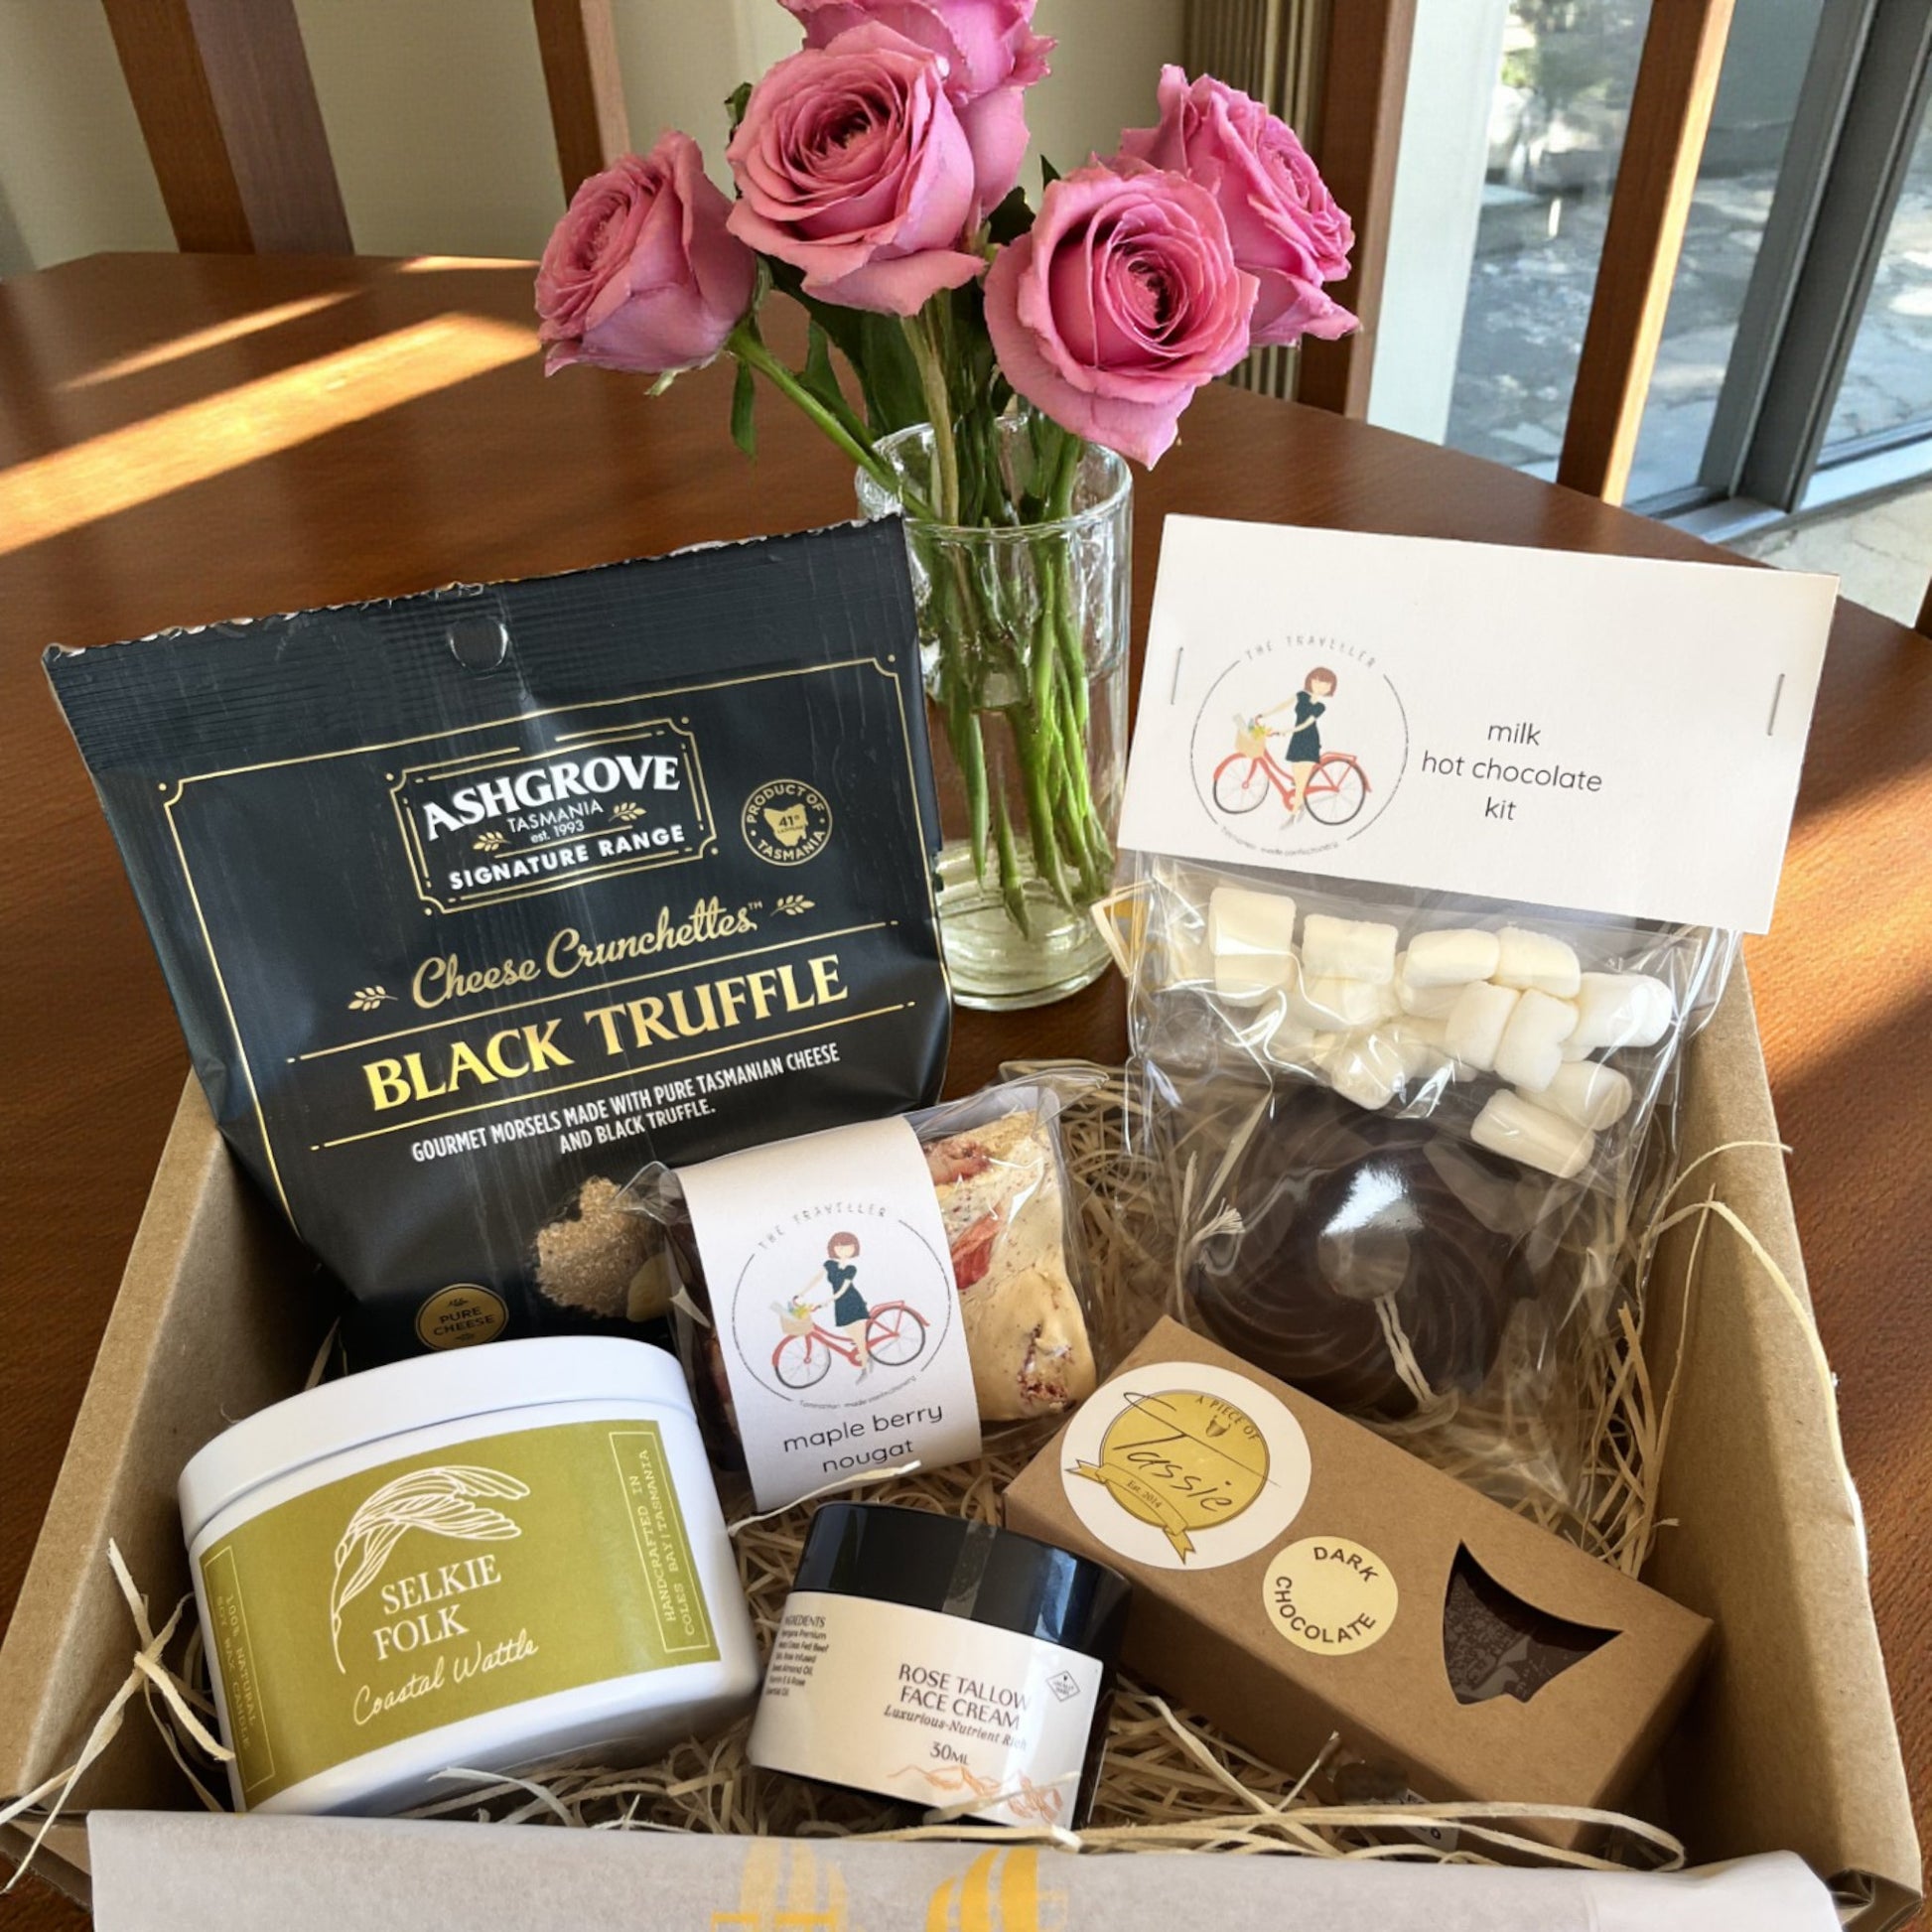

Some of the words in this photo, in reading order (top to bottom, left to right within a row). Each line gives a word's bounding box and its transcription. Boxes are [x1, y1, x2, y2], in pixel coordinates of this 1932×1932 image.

[1245, 640, 1272, 660] THE
[1286, 635, 1376, 668] TRAVELLER
[1488, 722, 1541, 746] milk
[1422, 751, 1464, 776] hot
[1471, 757, 1602, 792] chocolate
[422, 755, 680, 841] ASHGROVE
[506, 798, 604, 833] TASMANIA
[747, 784, 806, 823] PRODUCT
[806, 793, 825, 811] OF
[1484, 796, 1517, 821] kit
[530, 830, 551, 843] est.
[553, 819, 585, 837] 1993
[758, 832, 826, 861] TASMANIA
[449, 843, 589, 891] SIGNATURE
[600, 824, 685, 858] RANGE
[412, 953, 540, 1010] Cheese
[362, 1018, 574, 1110] BLACK
[584, 954, 848, 1055] TRUFFLE
[411, 1127, 487, 1162] GOURMET
[491, 1112, 562, 1145] MORSELS
[565, 1102, 609, 1130] MADE
[611, 1089, 651, 1118] WITH
[653, 1080, 695, 1108] PURE
[696, 1058, 784, 1094] TASMANIAN
[786, 1042, 840, 1070] CHEESE
[559, 1130, 593, 1154] AND
[597, 1115, 644, 1143] BLACK
[645, 1101, 716, 1132] TRUFFLE.
[758, 1225, 783, 1249] THE
[793, 1202, 886, 1223] TRAVELLER
[434, 1314, 494, 1336] CHEESE
[440, 1307, 482, 1324] PURE
[783, 1422, 867, 1453] maple
[873, 1406, 942, 1436] berry
[1194, 1395, 1205, 1405] A
[1209, 1399, 1244, 1425] PIECE
[1243, 1425, 1260, 1440] OF
[823, 1440, 914, 1473] nougat
[1113, 1392, 1281, 1512] Tassie
[629, 1475, 642, 1494] IN
[381, 1554, 501, 1615] SELKIE
[638, 1505, 676, 1622] HANDCRAFTED
[1313, 1547, 1378, 1583] DARK
[373, 1604, 470, 1661] FOLK
[674, 1583, 695, 1636] COLES
[1275, 1576, 1377, 1643] CHOCOLATE
[216, 1595, 227, 1625] SOY
[223, 1638, 235, 1671] WAX
[232, 1682, 250, 1748] CANDLE
[236, 1647, 257, 1725] NATURAL
[353, 1656, 445, 1725] Coastal
[453, 1628, 538, 1683] Wattle
[898, 1663, 951, 1691] ROSE
[957, 1676, 1032, 1711] TALLOW
[884, 1704, 1001, 1743] Luxurious-Nutrient
[1002, 1734, 1028, 1750] Rich
[899, 1686, 950, 1712] FACE
[953, 1699, 1020, 1729] CREAM
